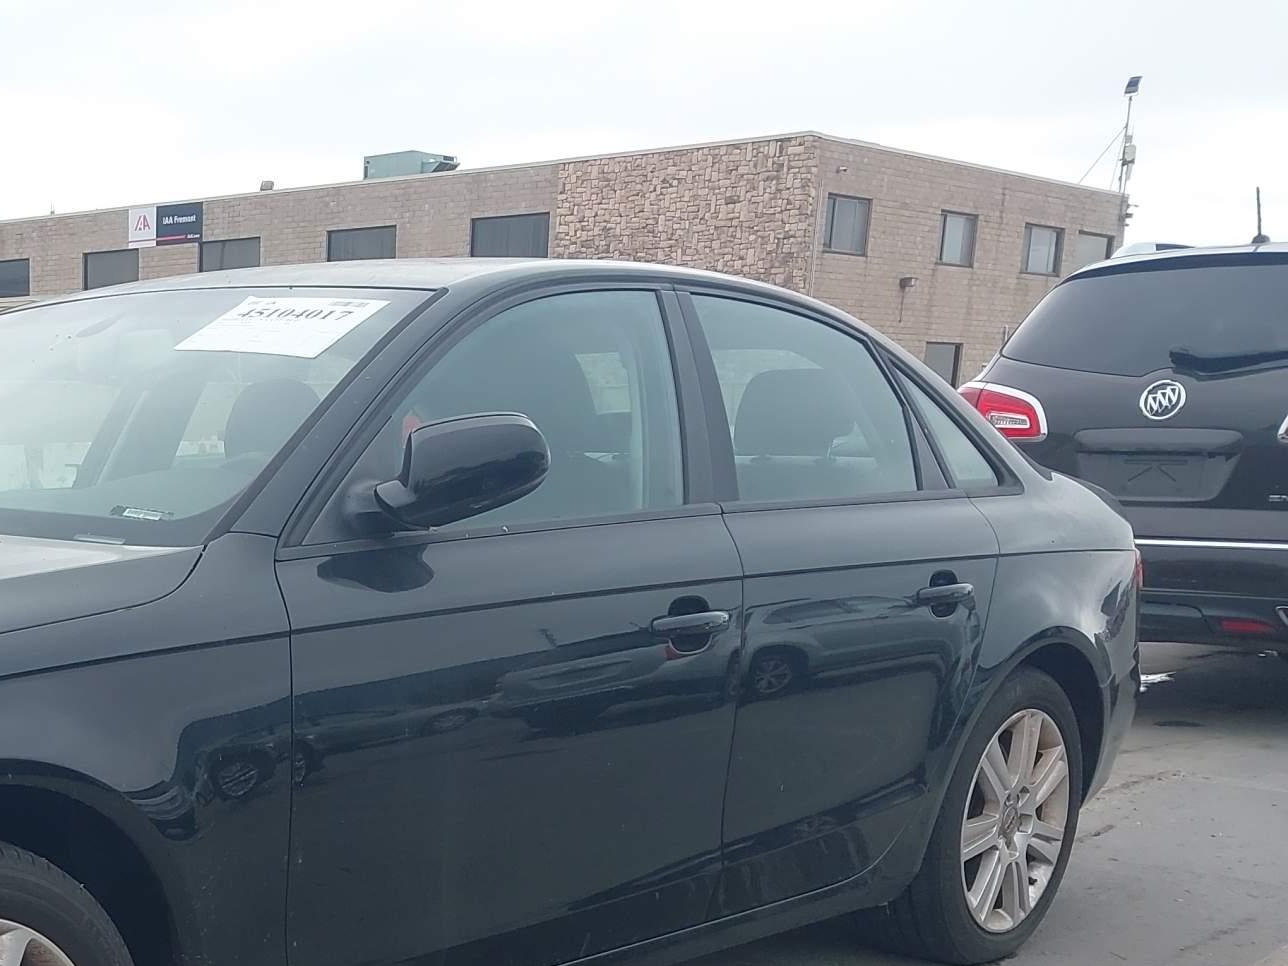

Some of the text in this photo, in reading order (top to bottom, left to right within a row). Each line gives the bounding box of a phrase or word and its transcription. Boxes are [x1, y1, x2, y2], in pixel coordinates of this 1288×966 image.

[162, 214, 196, 225] IAA Fremont
[238, 308, 354, 321] 45104017
